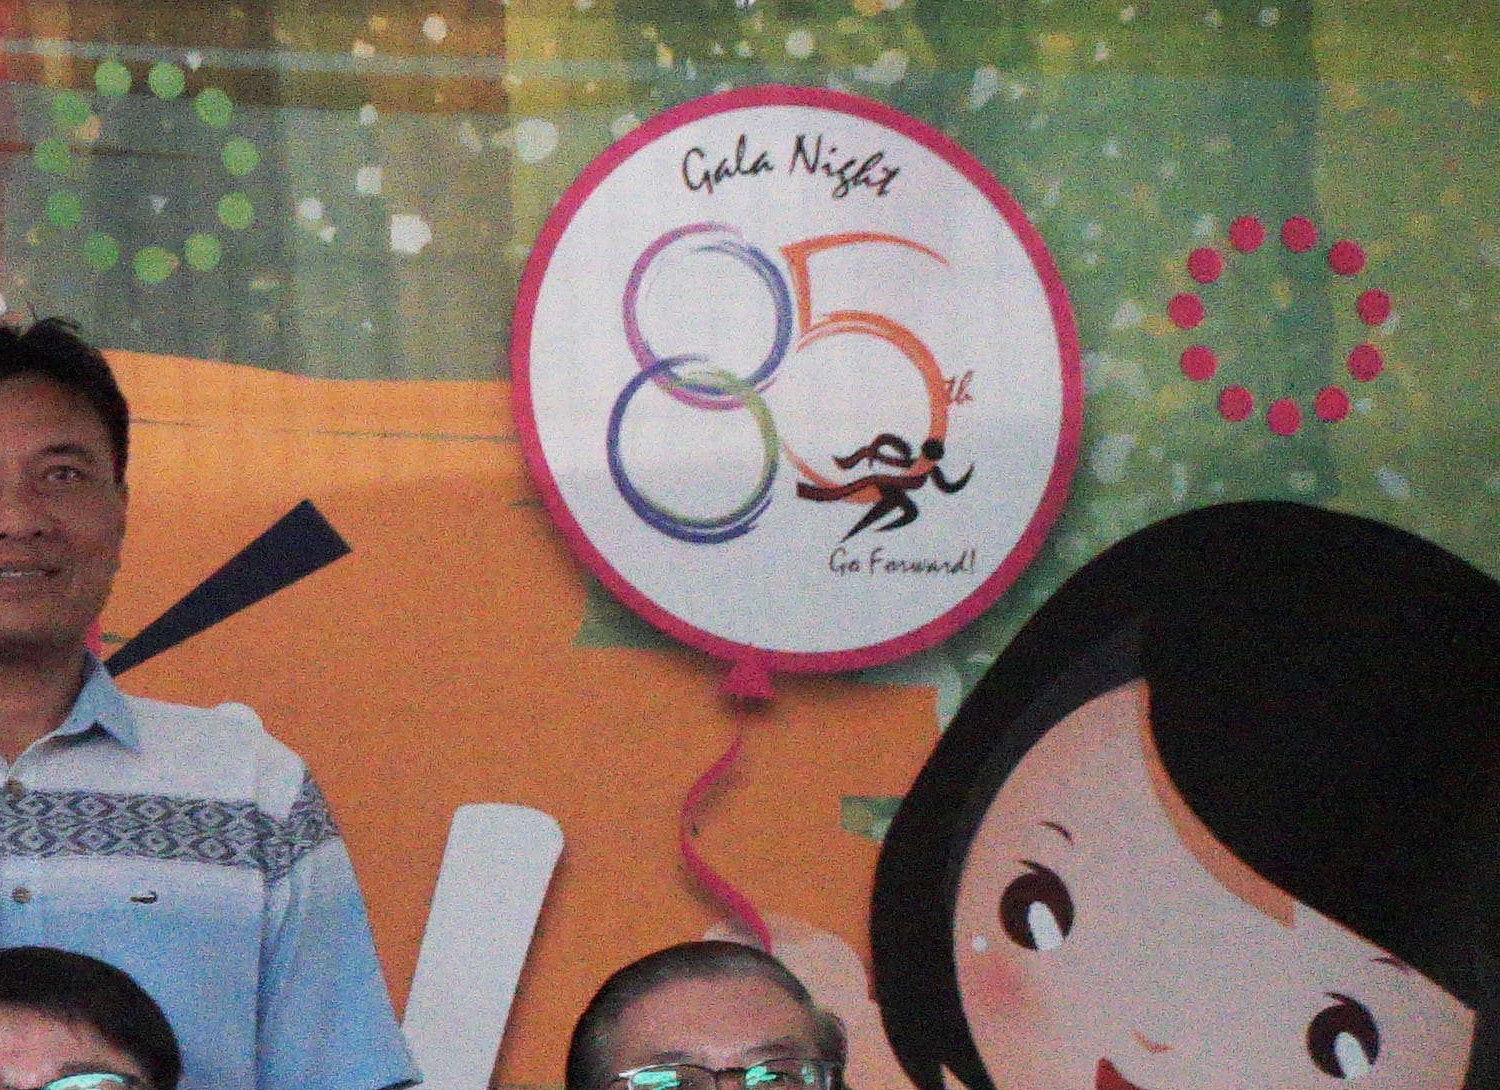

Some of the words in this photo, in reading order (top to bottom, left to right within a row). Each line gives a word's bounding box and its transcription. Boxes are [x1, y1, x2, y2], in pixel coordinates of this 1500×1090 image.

[681, 135, 775, 195] Gala
[789, 136, 900, 197] Night
[828, 548, 861, 575] Go
[868, 548, 977, 576] Forward!
